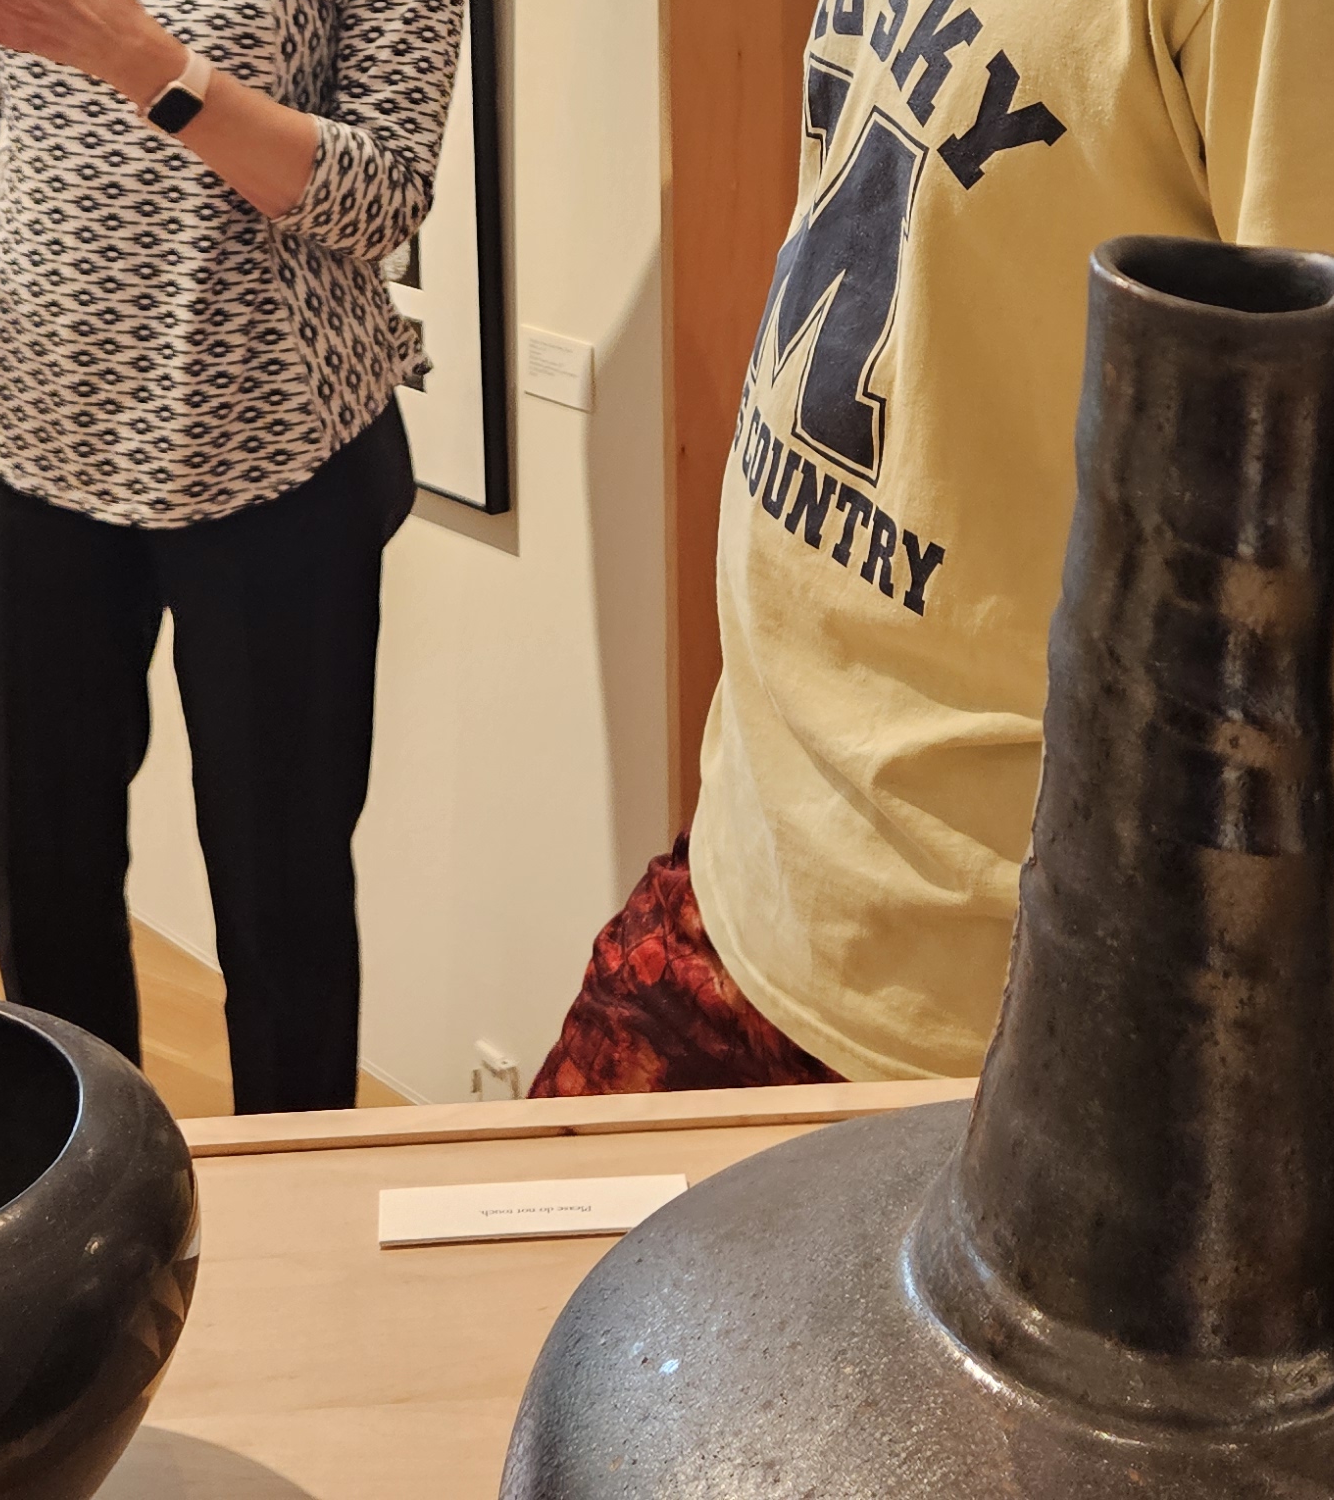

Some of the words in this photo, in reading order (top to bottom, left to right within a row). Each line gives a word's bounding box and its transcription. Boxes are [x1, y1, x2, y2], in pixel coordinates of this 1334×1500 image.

[742, 405, 946, 617] COUNTRY
[479, 1208, 513, 1217] touch.
[557, 1205, 592, 1213] Please
